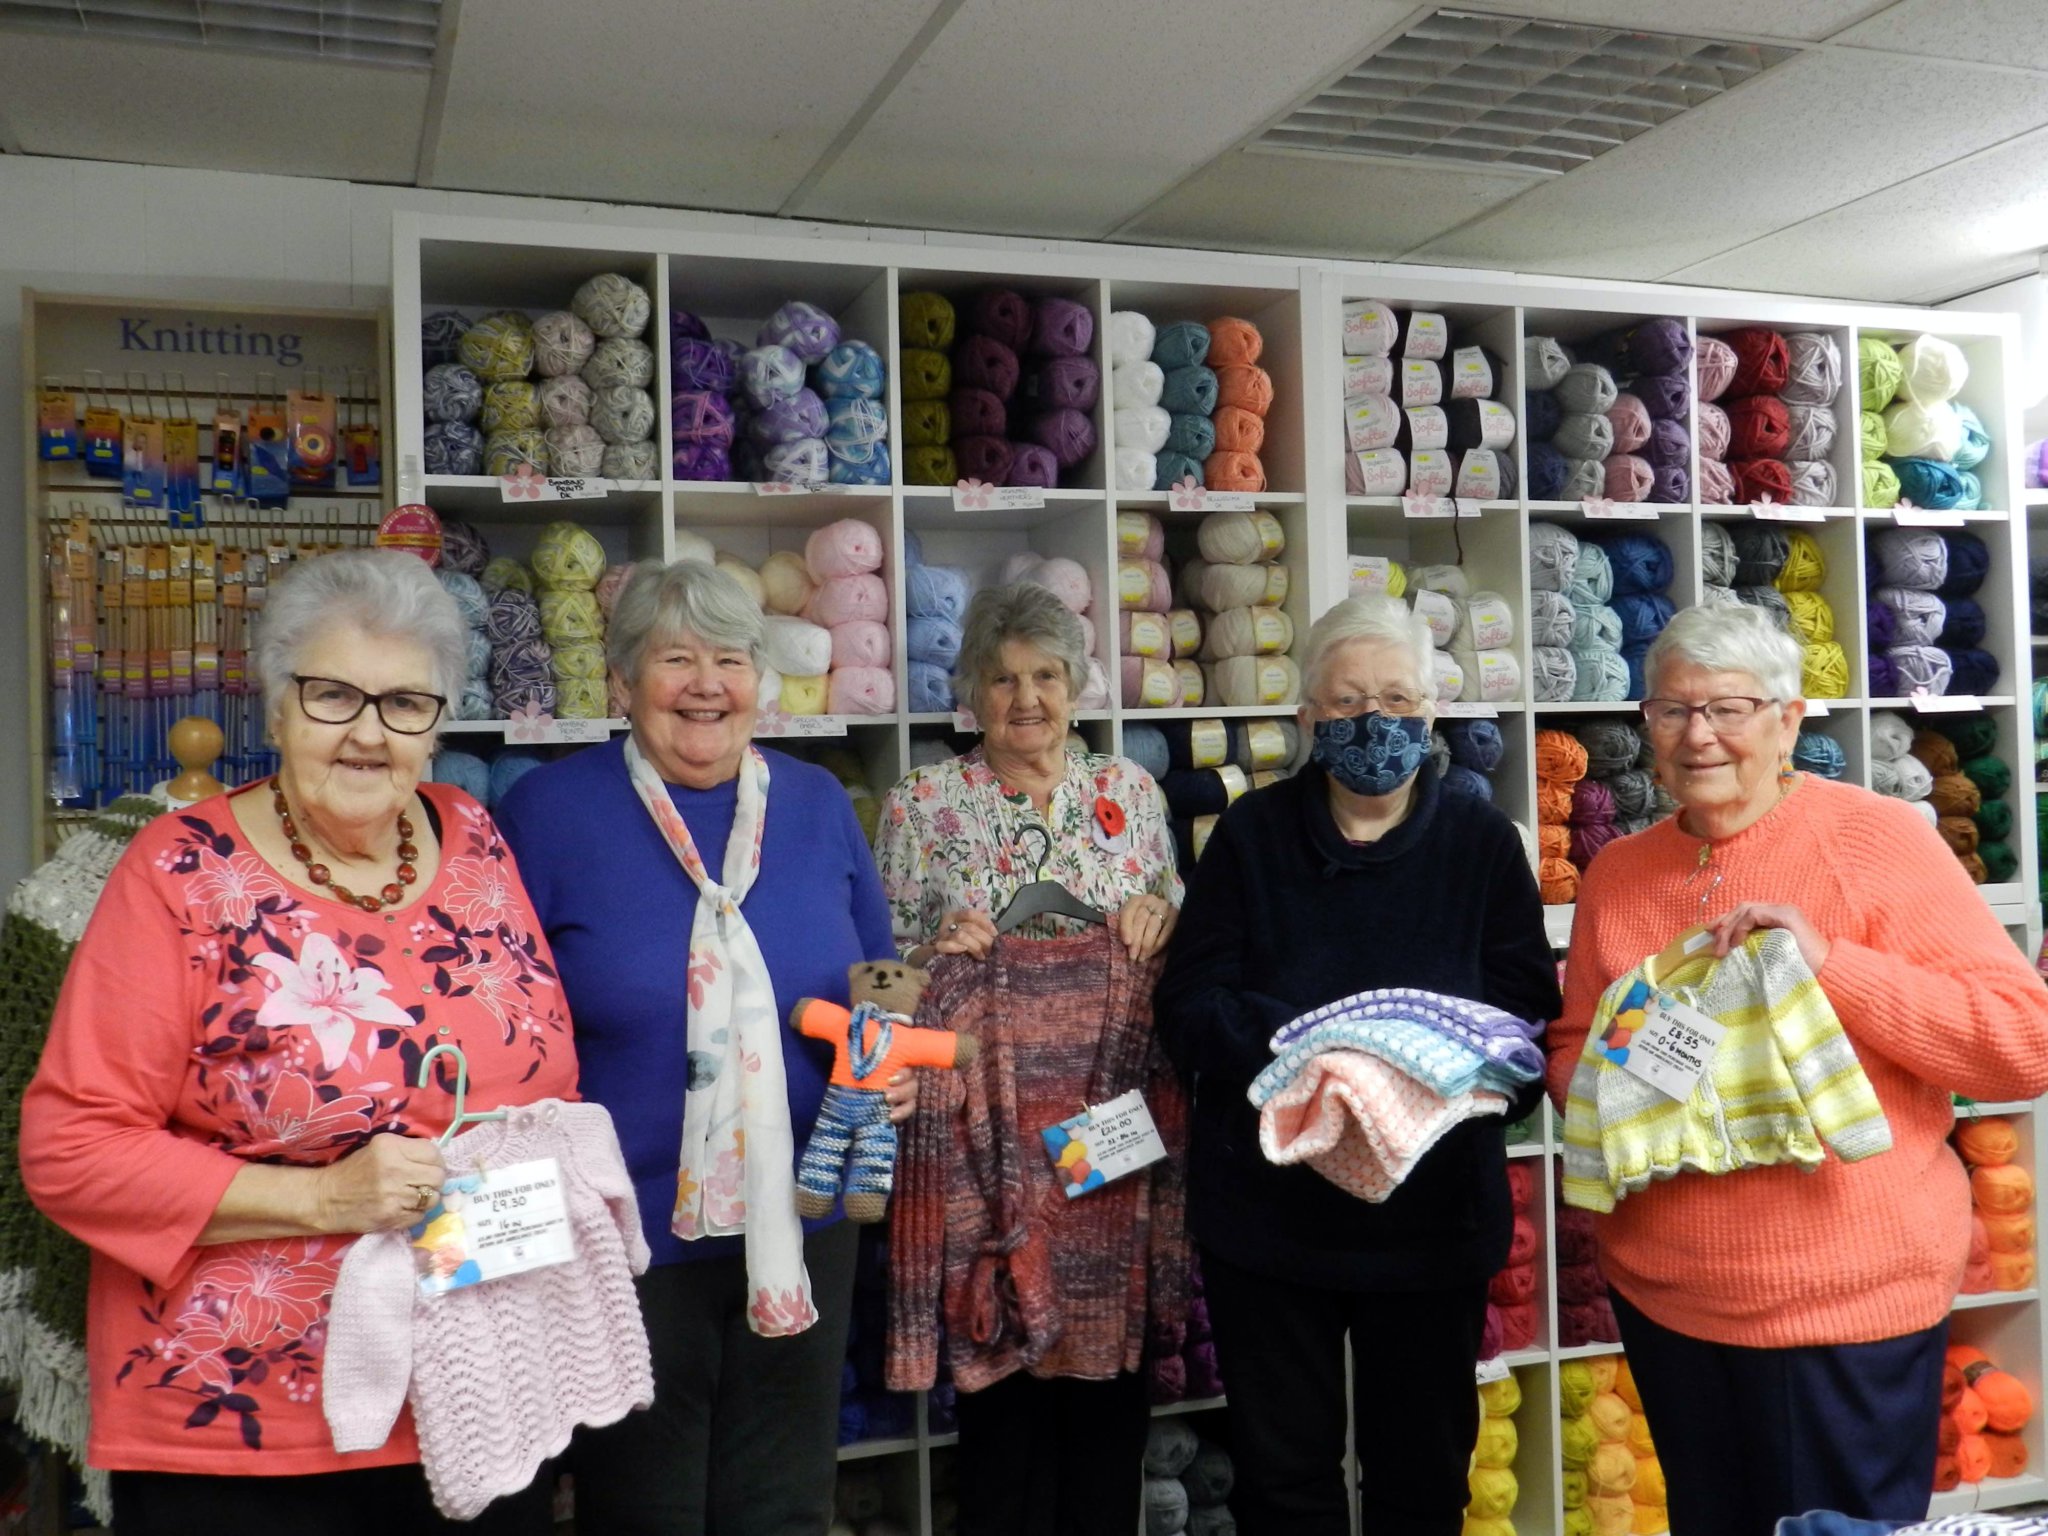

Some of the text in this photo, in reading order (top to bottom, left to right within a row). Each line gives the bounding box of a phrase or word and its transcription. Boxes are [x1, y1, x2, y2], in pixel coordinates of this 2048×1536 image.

[120, 318, 303, 367] Knitting
[1659, 1012, 1715, 1047] BUY THIS FOR ONLY
[1668, 1027, 1698, 1049] £8.55
[1675, 1048, 1702, 1067] MONTHS
[1088, 1123, 1100, 1131] BUY
[1101, 1117, 1115, 1126] THIS
[1129, 1104, 1143, 1113] ONLY
[473, 1179, 555, 1204] BUY THIS FOR ONLY
[492, 1196, 526, 1212] £9.30
